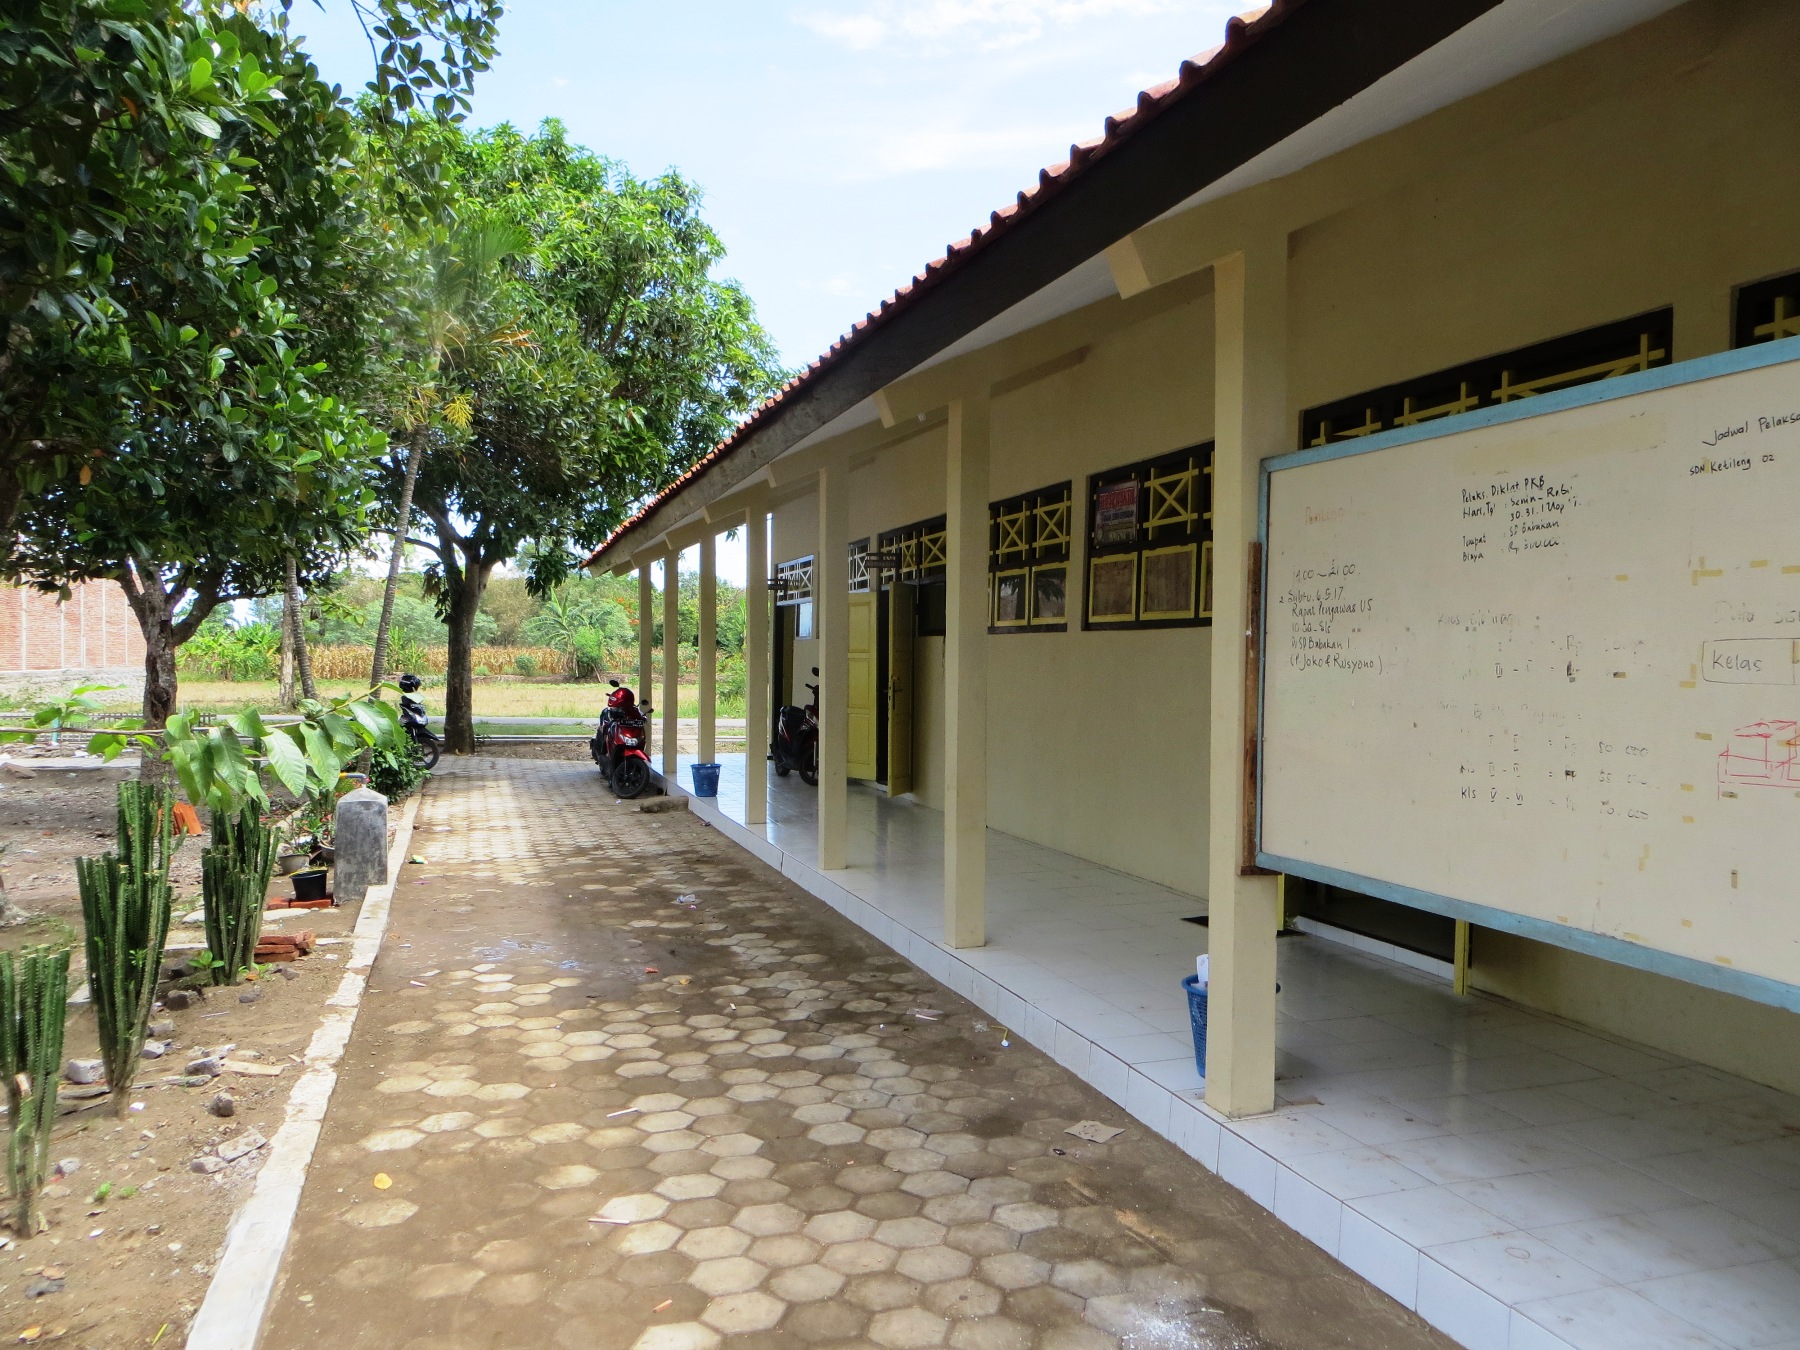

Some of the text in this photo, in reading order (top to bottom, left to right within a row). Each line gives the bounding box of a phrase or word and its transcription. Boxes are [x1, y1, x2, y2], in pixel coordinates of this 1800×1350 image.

[1702, 421, 1748, 446] Jadwal
[1690, 454, 1775, 476] SDN Ketileng 02
[1524, 475, 1545, 490] PKB
[1712, 649, 1762, 672] Kelas
